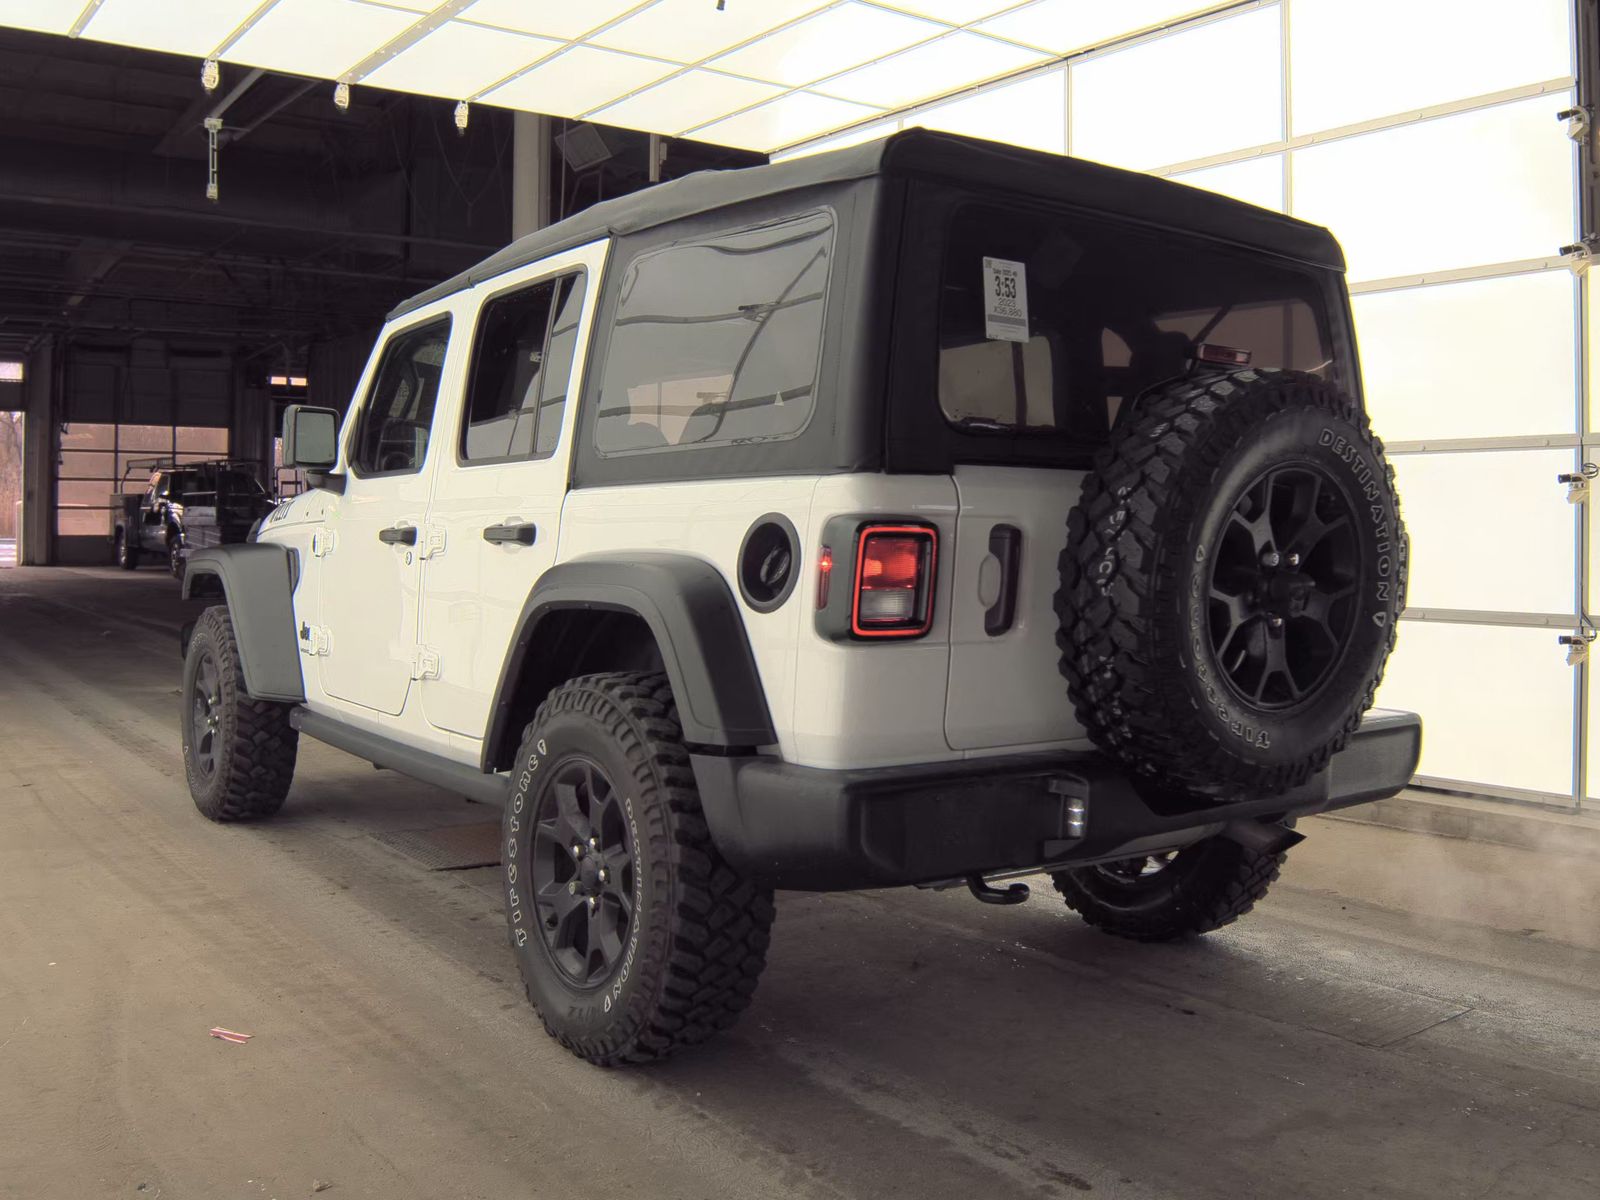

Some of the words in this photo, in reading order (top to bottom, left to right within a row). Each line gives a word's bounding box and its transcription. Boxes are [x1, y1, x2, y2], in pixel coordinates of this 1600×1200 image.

[995, 275, 1016, 299] 3:53
[1317, 427, 1391, 601] DESTINATION
[507, 754, 539, 947] FIRESTONE
[613, 797, 642, 1000] DESTINATION
